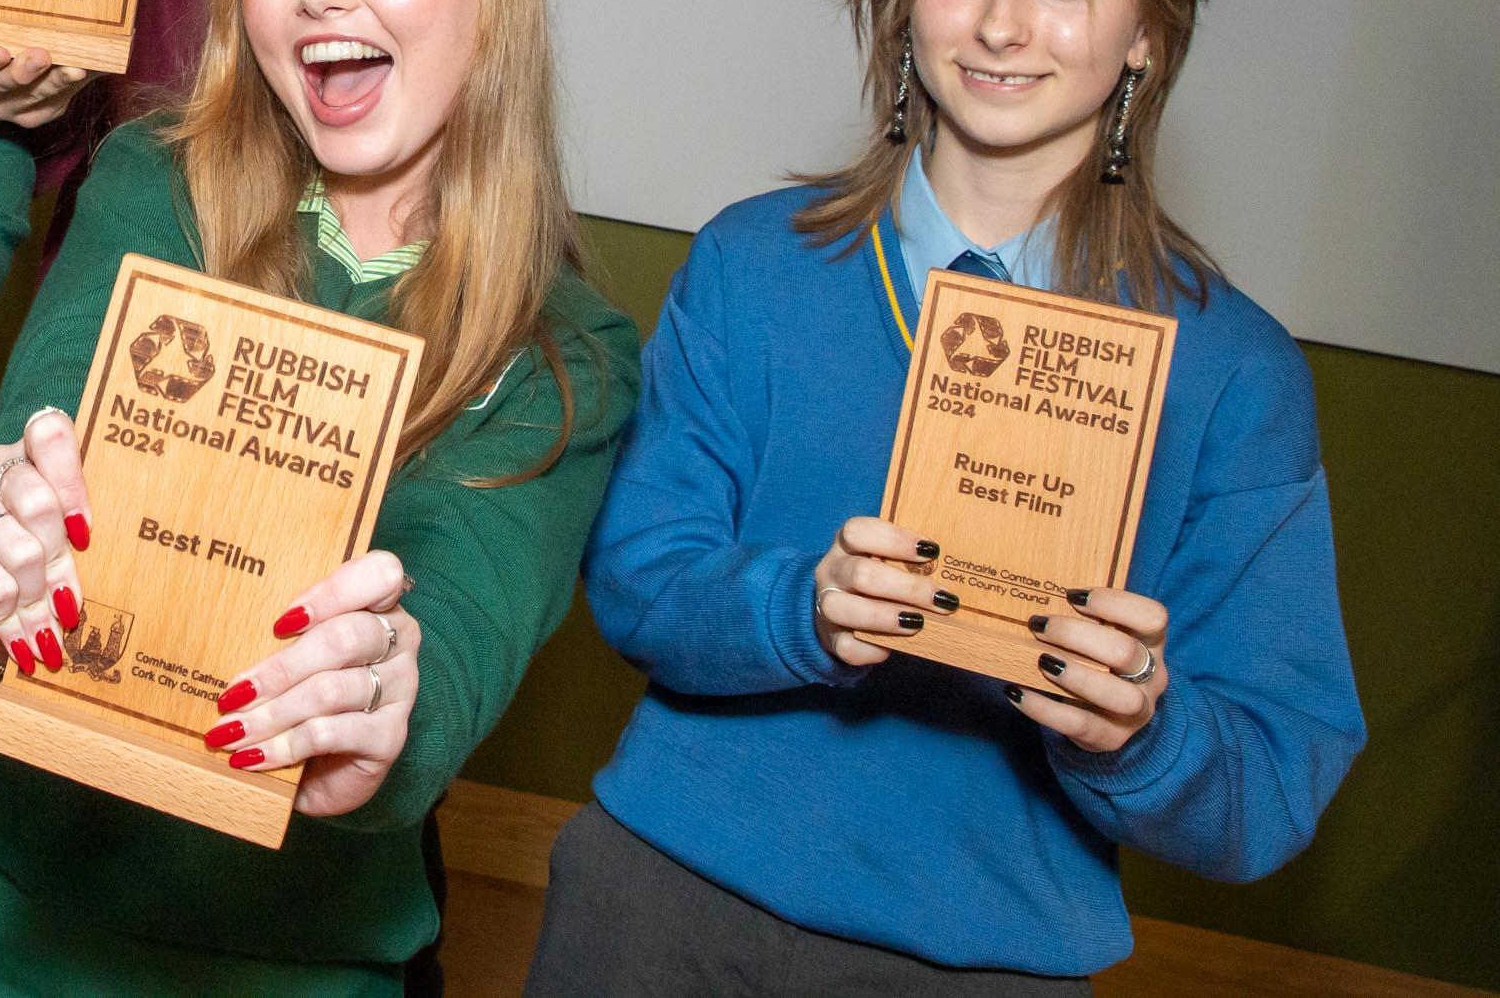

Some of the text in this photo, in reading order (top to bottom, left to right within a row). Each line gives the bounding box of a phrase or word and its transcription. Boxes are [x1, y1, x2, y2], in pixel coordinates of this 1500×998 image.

[1019, 347, 1079, 376] FILM
[1023, 325, 1136, 366] RUBBISH
[225, 366, 298, 407] FILM
[234, 336, 371, 398] RUBBISH
[927, 395, 976, 418] 2024
[930, 374, 1130, 435] National Awards
[1014, 367, 1134, 411] FESTIVAL
[104, 424, 165, 458] 2024
[110, 395, 354, 490] National Awards
[217, 394, 362, 459] FESTIVAL
[954, 452, 1075, 497] Runner Up
[958, 478, 1062, 518] Best Film
[138, 517, 267, 577] Best Film
[941, 570, 1050, 605] Cork County Council
[944, 555, 1041, 587] Comhairle Contae
[131, 666, 220, 702] Cork City Council
